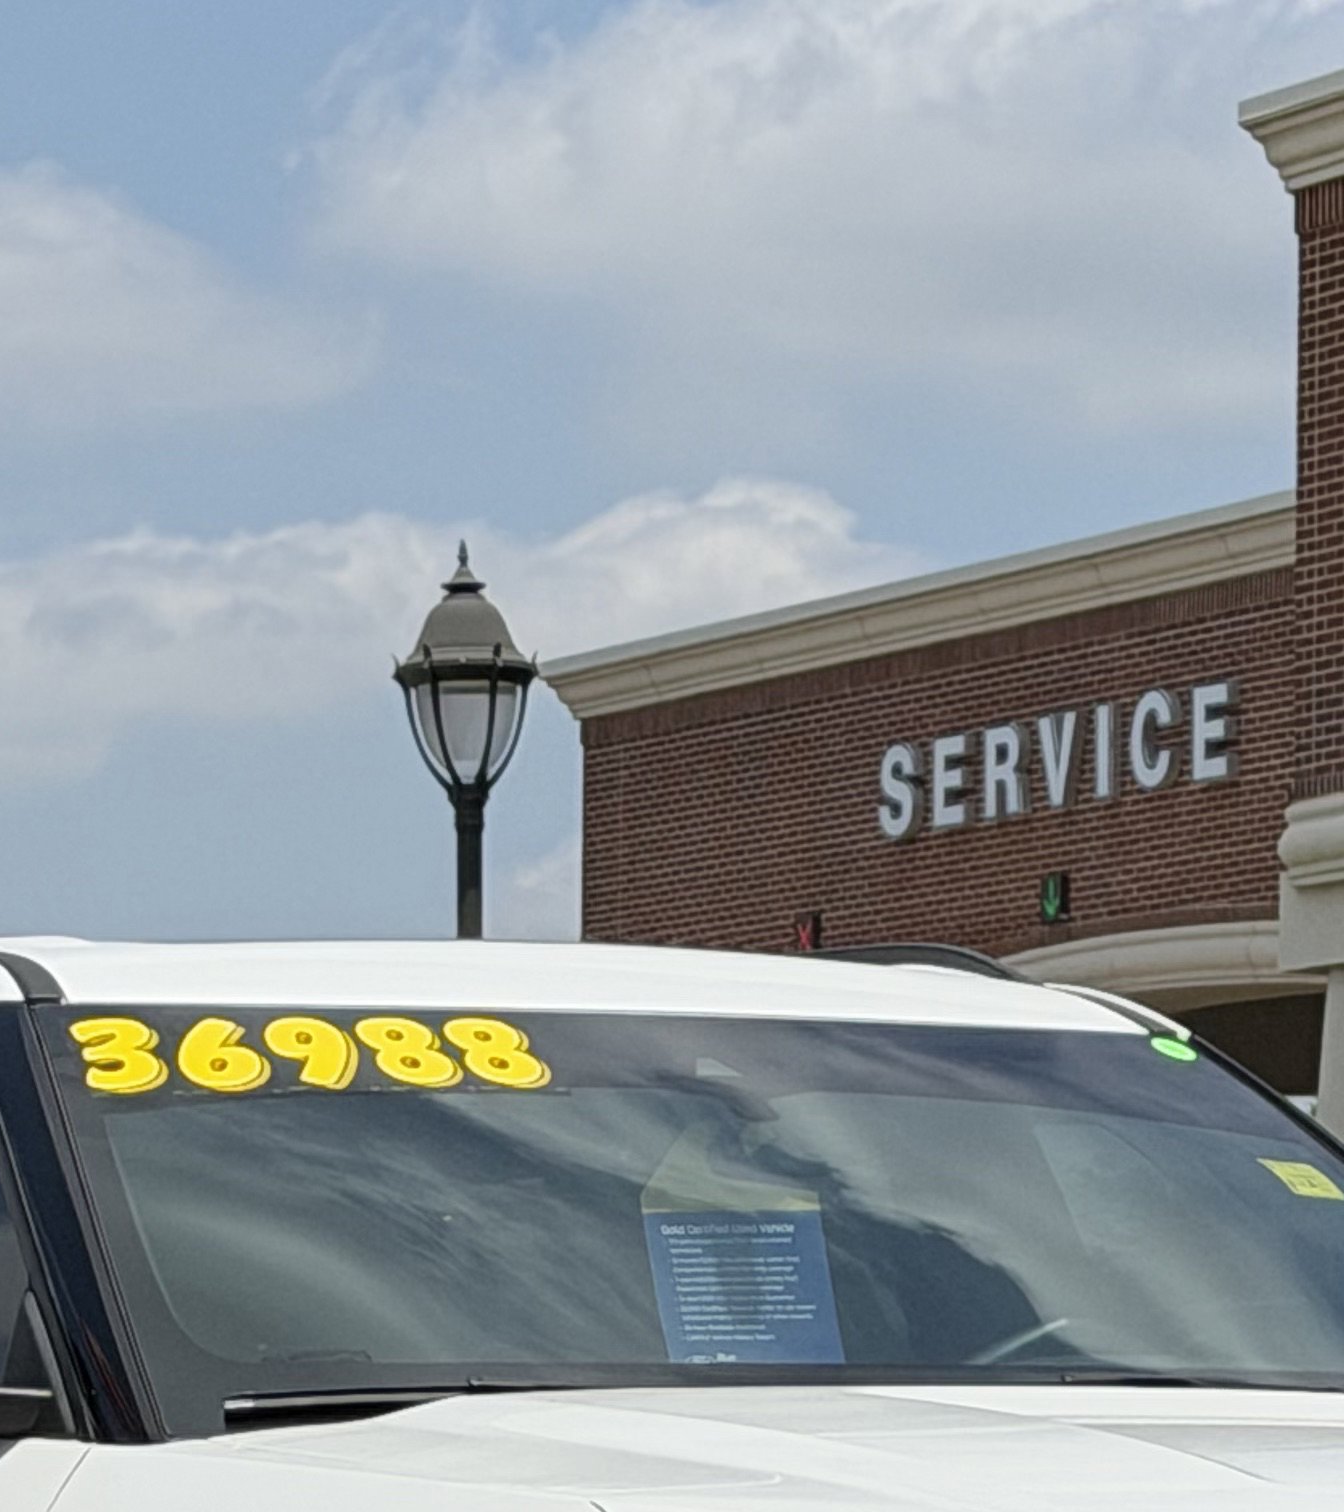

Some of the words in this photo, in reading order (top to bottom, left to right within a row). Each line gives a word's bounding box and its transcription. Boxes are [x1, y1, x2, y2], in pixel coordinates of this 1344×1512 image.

[878, 681, 1238, 839] SERVICE
[69, 1016, 552, 1095] 36988
[660, 1224, 685, 1235] Gold
[758, 1223, 795, 1234] Vehicle
